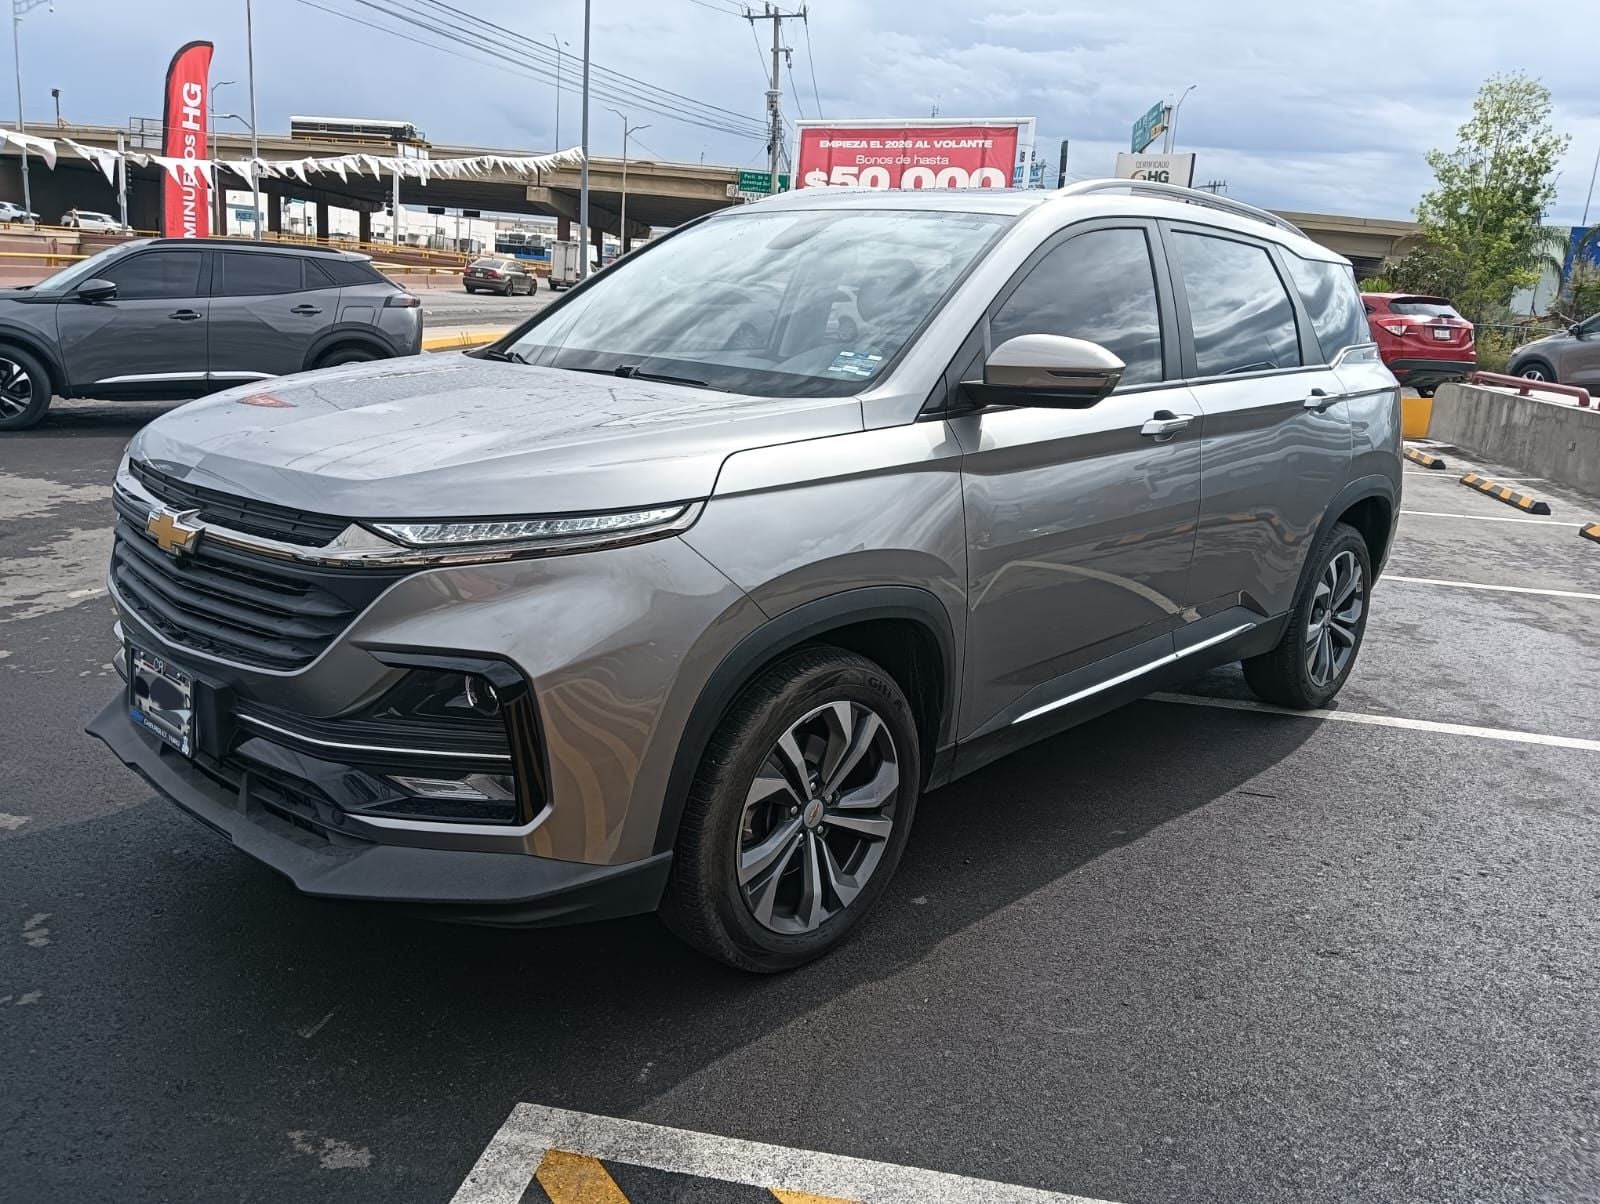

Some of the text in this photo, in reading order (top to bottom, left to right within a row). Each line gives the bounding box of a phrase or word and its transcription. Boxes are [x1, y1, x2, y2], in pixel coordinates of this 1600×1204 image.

[819, 139, 993, 149] EMPIEZA EL 2026 AL VOLANTE
[181, 82, 202, 239] MINUEOS HG
[855, 154, 949, 165] Bonos de hasta
[1135, 159, 1170, 168] CERTIFICADO
[804, 165, 1006, 189] $50000
[1147, 170, 1170, 183] HG
